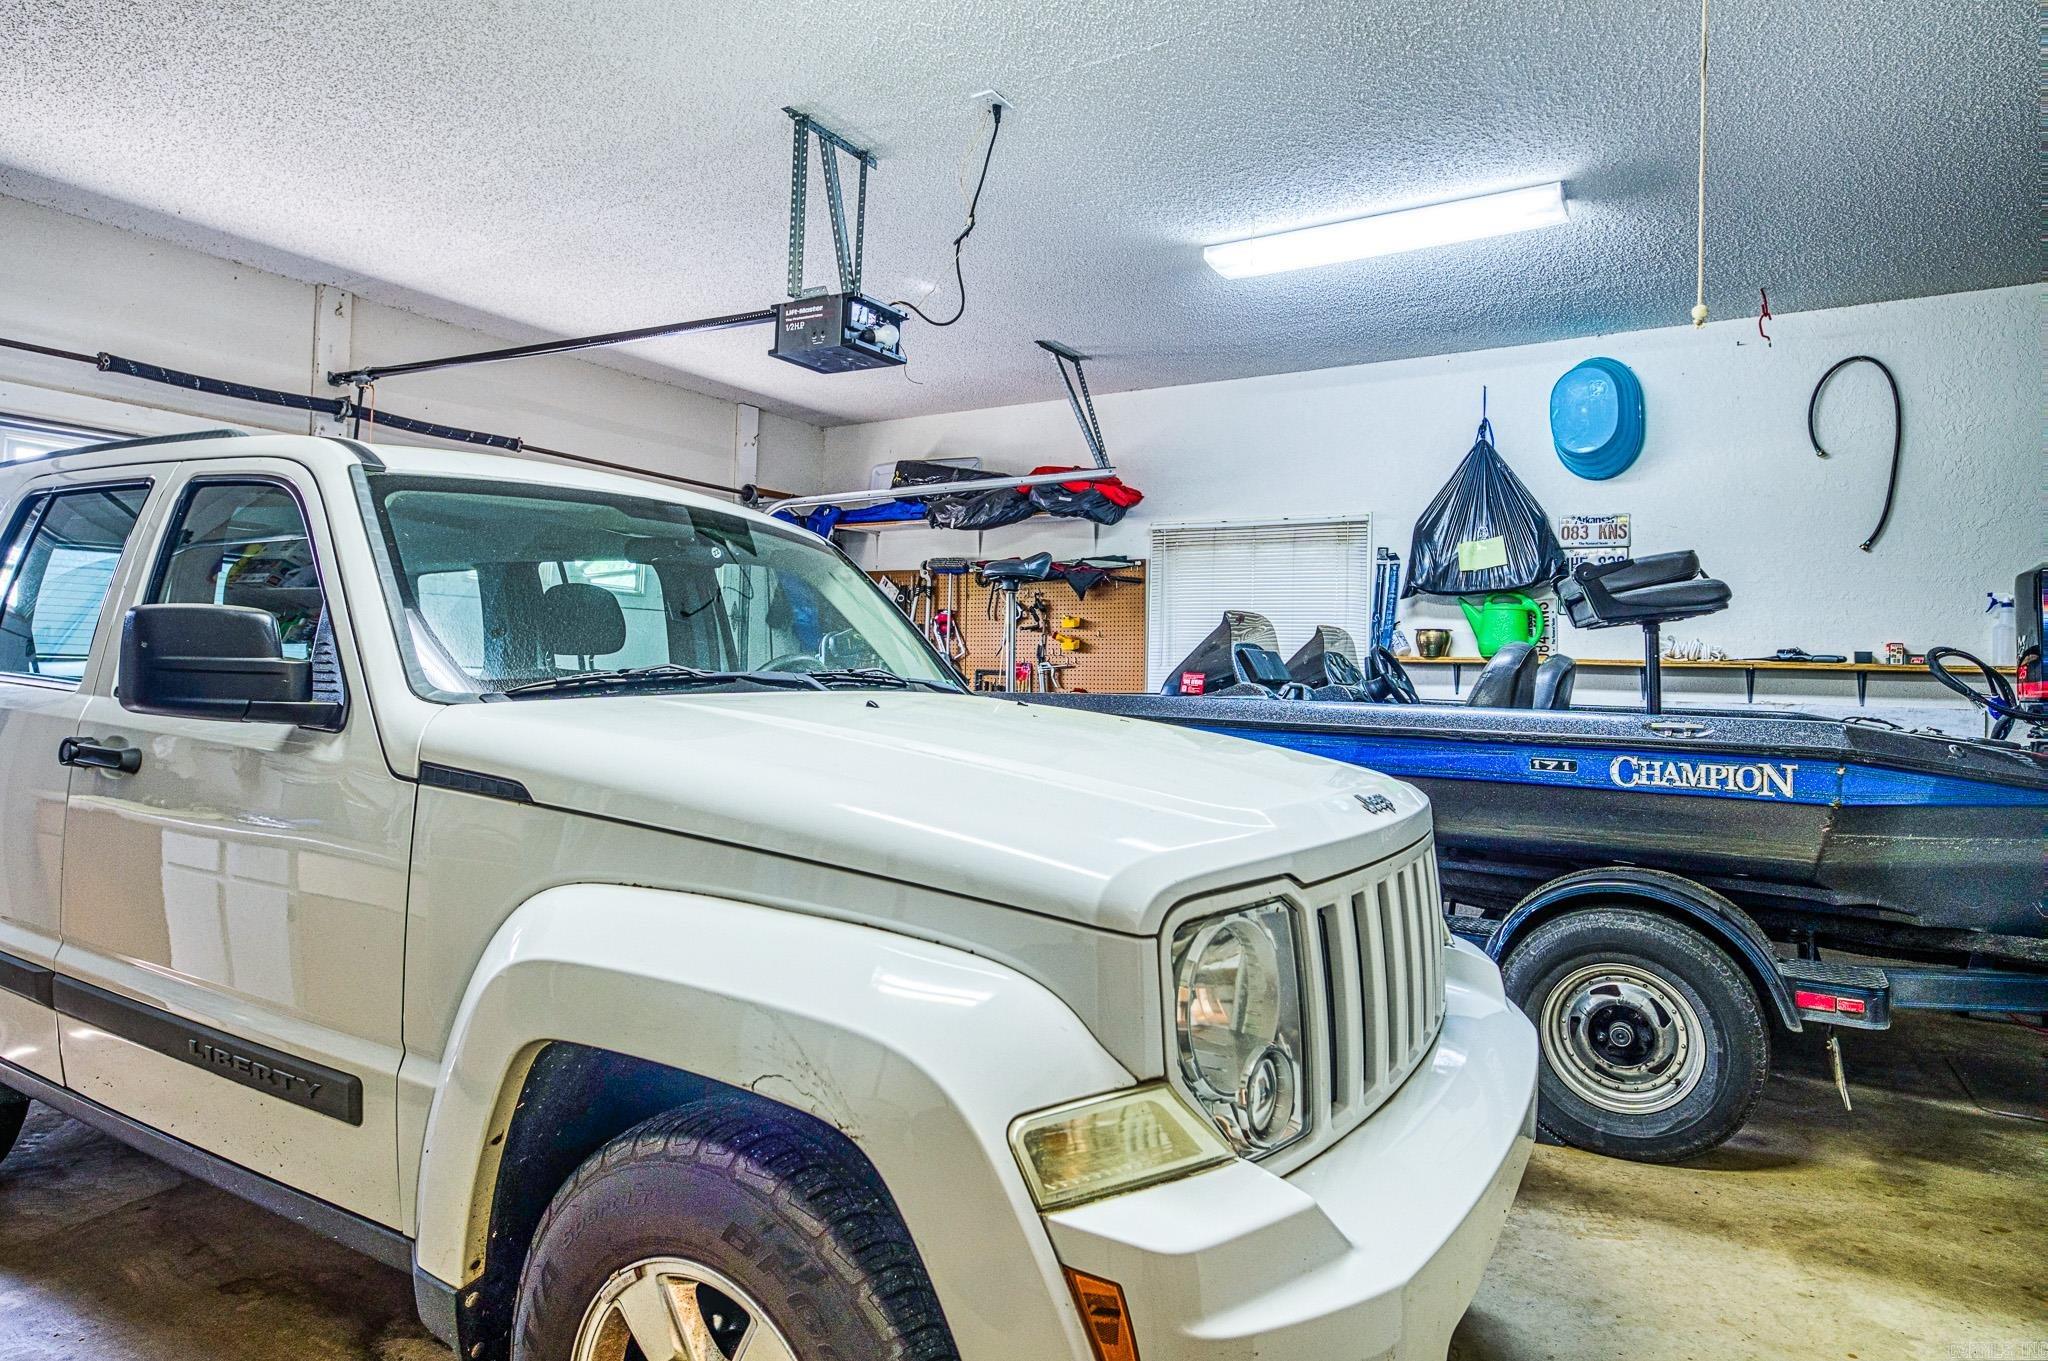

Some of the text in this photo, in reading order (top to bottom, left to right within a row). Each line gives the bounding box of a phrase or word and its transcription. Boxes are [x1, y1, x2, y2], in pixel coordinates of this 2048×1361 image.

[1561, 523, 1628, 541] 083 KNS
[1575, 516, 1615, 525] Arkansas
[1533, 755, 1798, 798] 171 CHAMPION
[188, 1039, 321, 1099] LIBERTY
